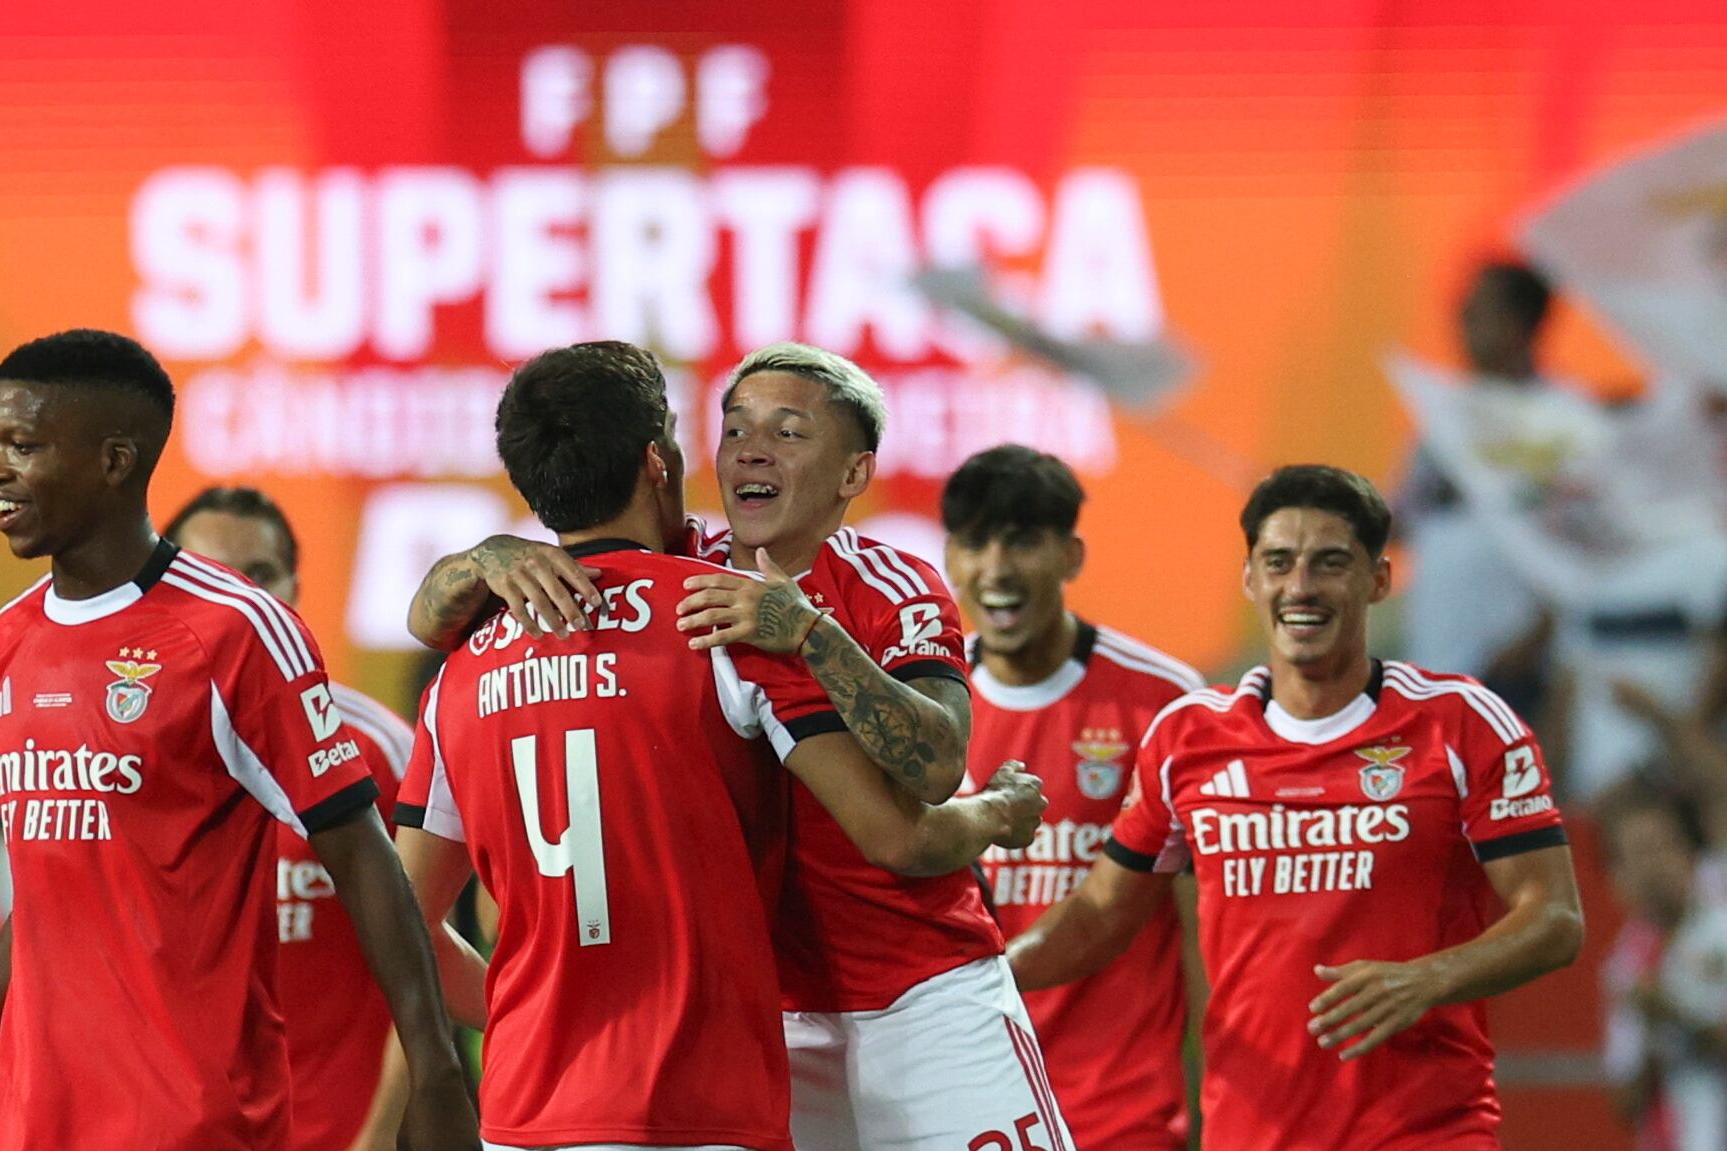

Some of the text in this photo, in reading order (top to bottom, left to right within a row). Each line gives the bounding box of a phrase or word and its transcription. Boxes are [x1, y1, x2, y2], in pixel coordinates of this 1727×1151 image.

[478, 647, 627, 718] ANTÓNIO S.
[23, 799, 111, 840] BETTER
[512, 729, 610, 947] 4
[1191, 804, 1410, 855] Emirates
[1224, 850, 1374, 897] FLY BETTER
